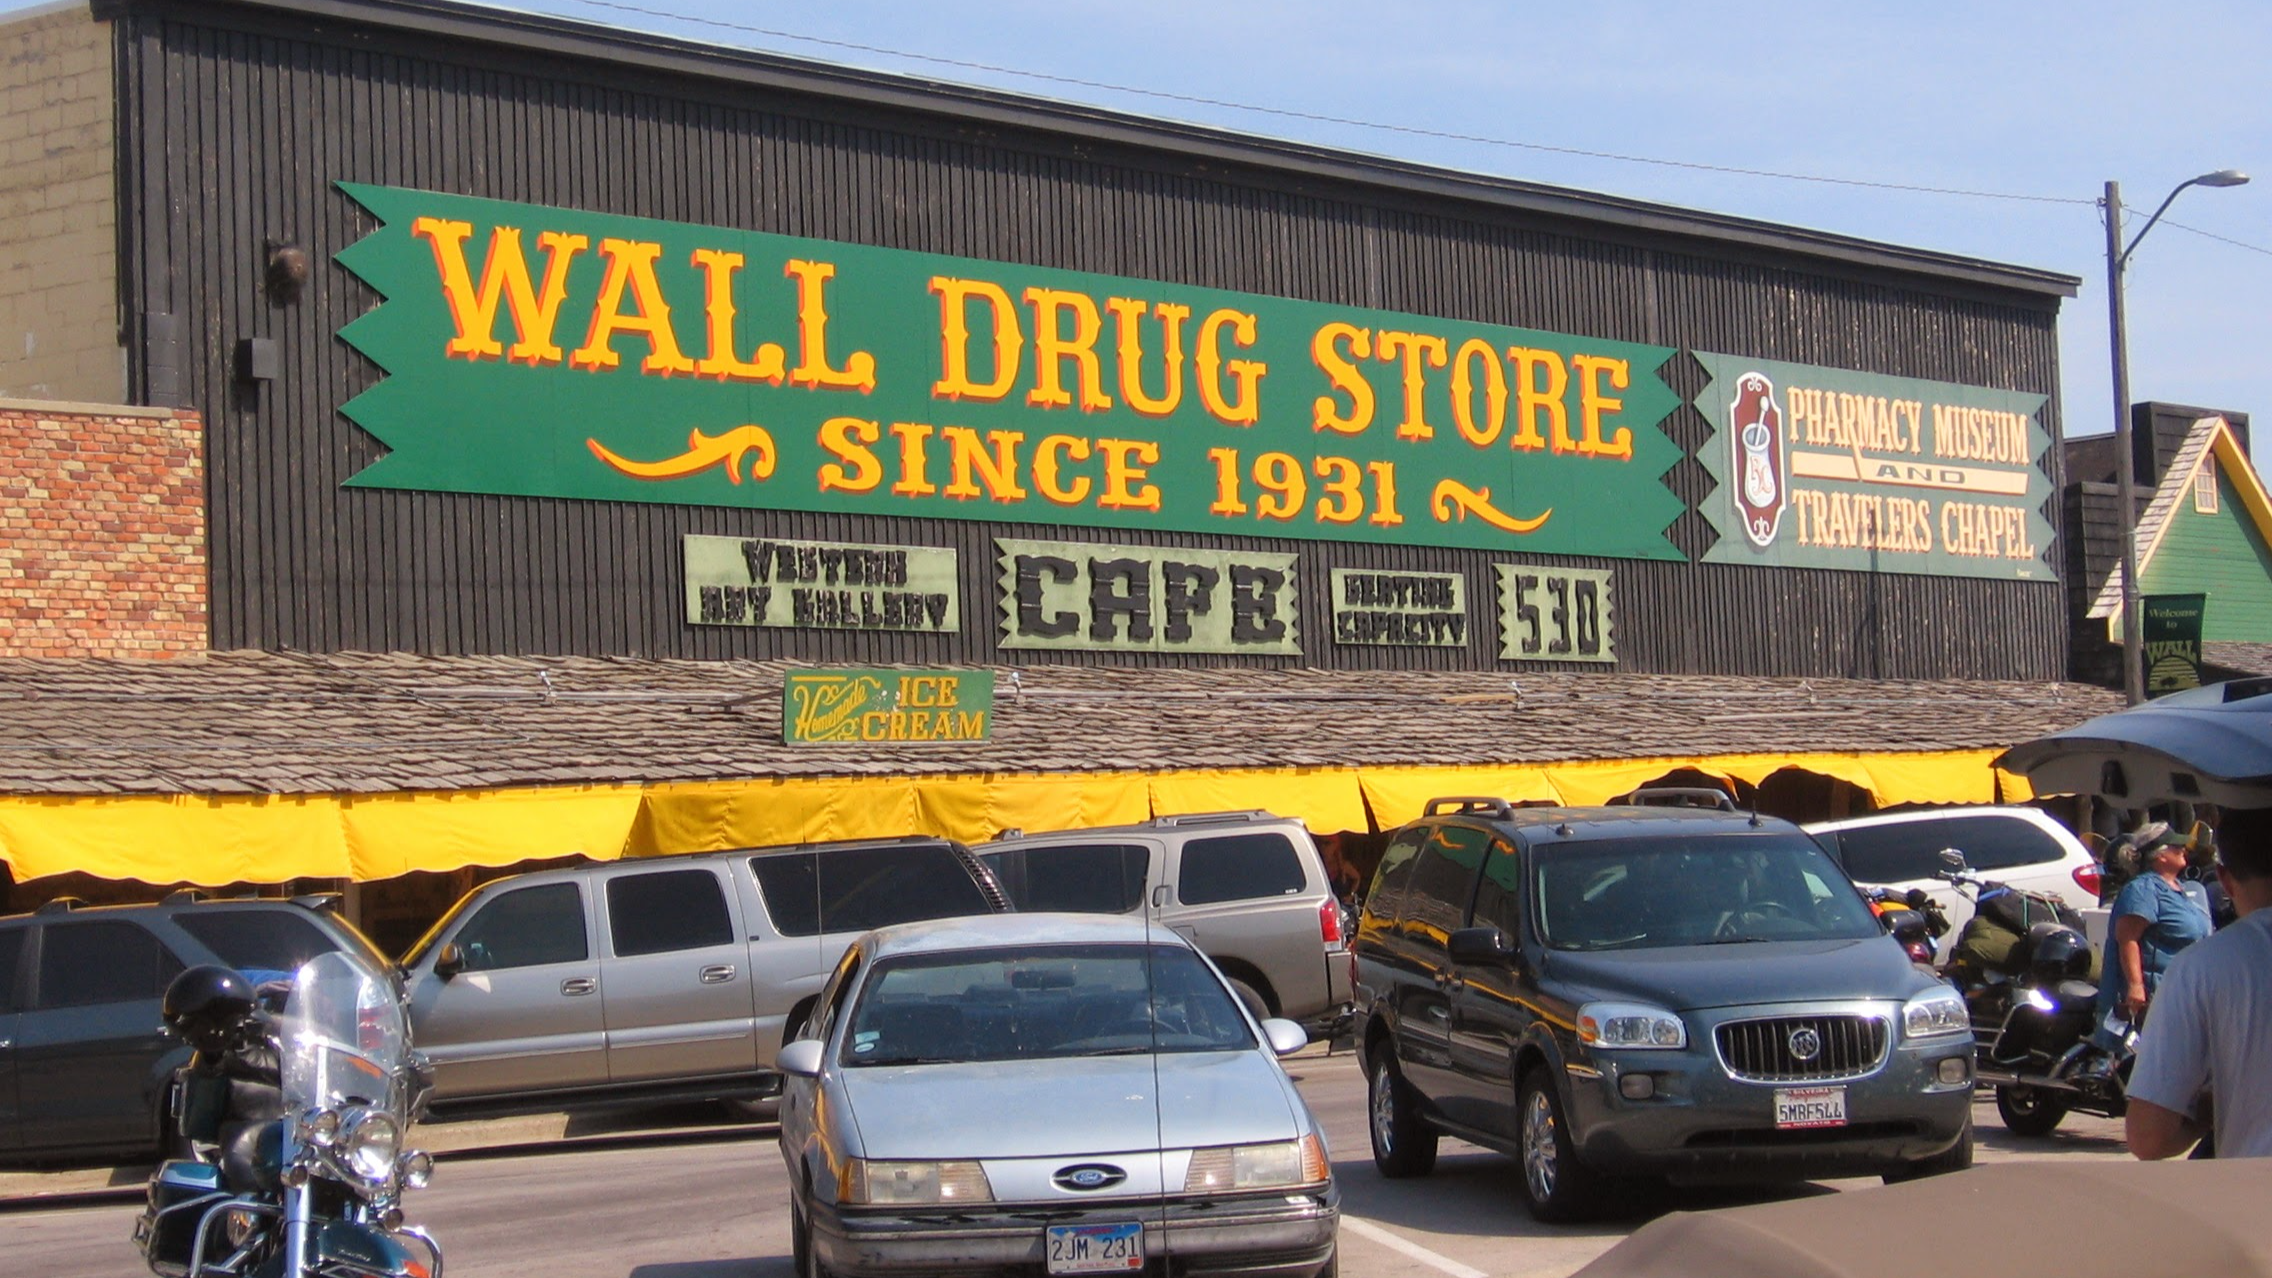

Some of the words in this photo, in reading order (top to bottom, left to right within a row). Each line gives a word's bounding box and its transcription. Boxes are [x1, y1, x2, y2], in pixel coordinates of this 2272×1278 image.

[412, 217, 877, 395] WALL
[928, 276, 1266, 427] DRUG
[1311, 322, 1633, 462] STORE
[1786, 386, 1923, 456] PHARMACY
[1933, 403, 2030, 466] MUSEUM
[816, 417, 1160, 512] SINCE
[1209, 447, 1404, 527] 1931
[1876, 464, 1966, 484] AND
[1791, 489, 1932, 554] TRAVELERS
[1940, 501, 2034, 560] CHAPEL
[742, 539, 908, 587] WESTERN
[700, 585, 772, 623] ART
[793, 587, 949, 629] GALLERY
[1014, 554, 1286, 643] CAFE
[1344, 574, 1454, 609] SEATING
[1337, 611, 1465, 645] CAPACITY
[1515, 574, 1600, 654] 530
[2150, 608, 2198, 618] Welcome
[2166, 620, 2178, 629] to
[2146, 639, 2197, 666] WALL
[793, 678, 867, 742] Homemade
[898, 676, 959, 708] ICE
[860, 711, 985, 741] CREAM
[1052, 1239, 1089, 1261] 2JM
[1103, 1236, 1138, 1259] 231
